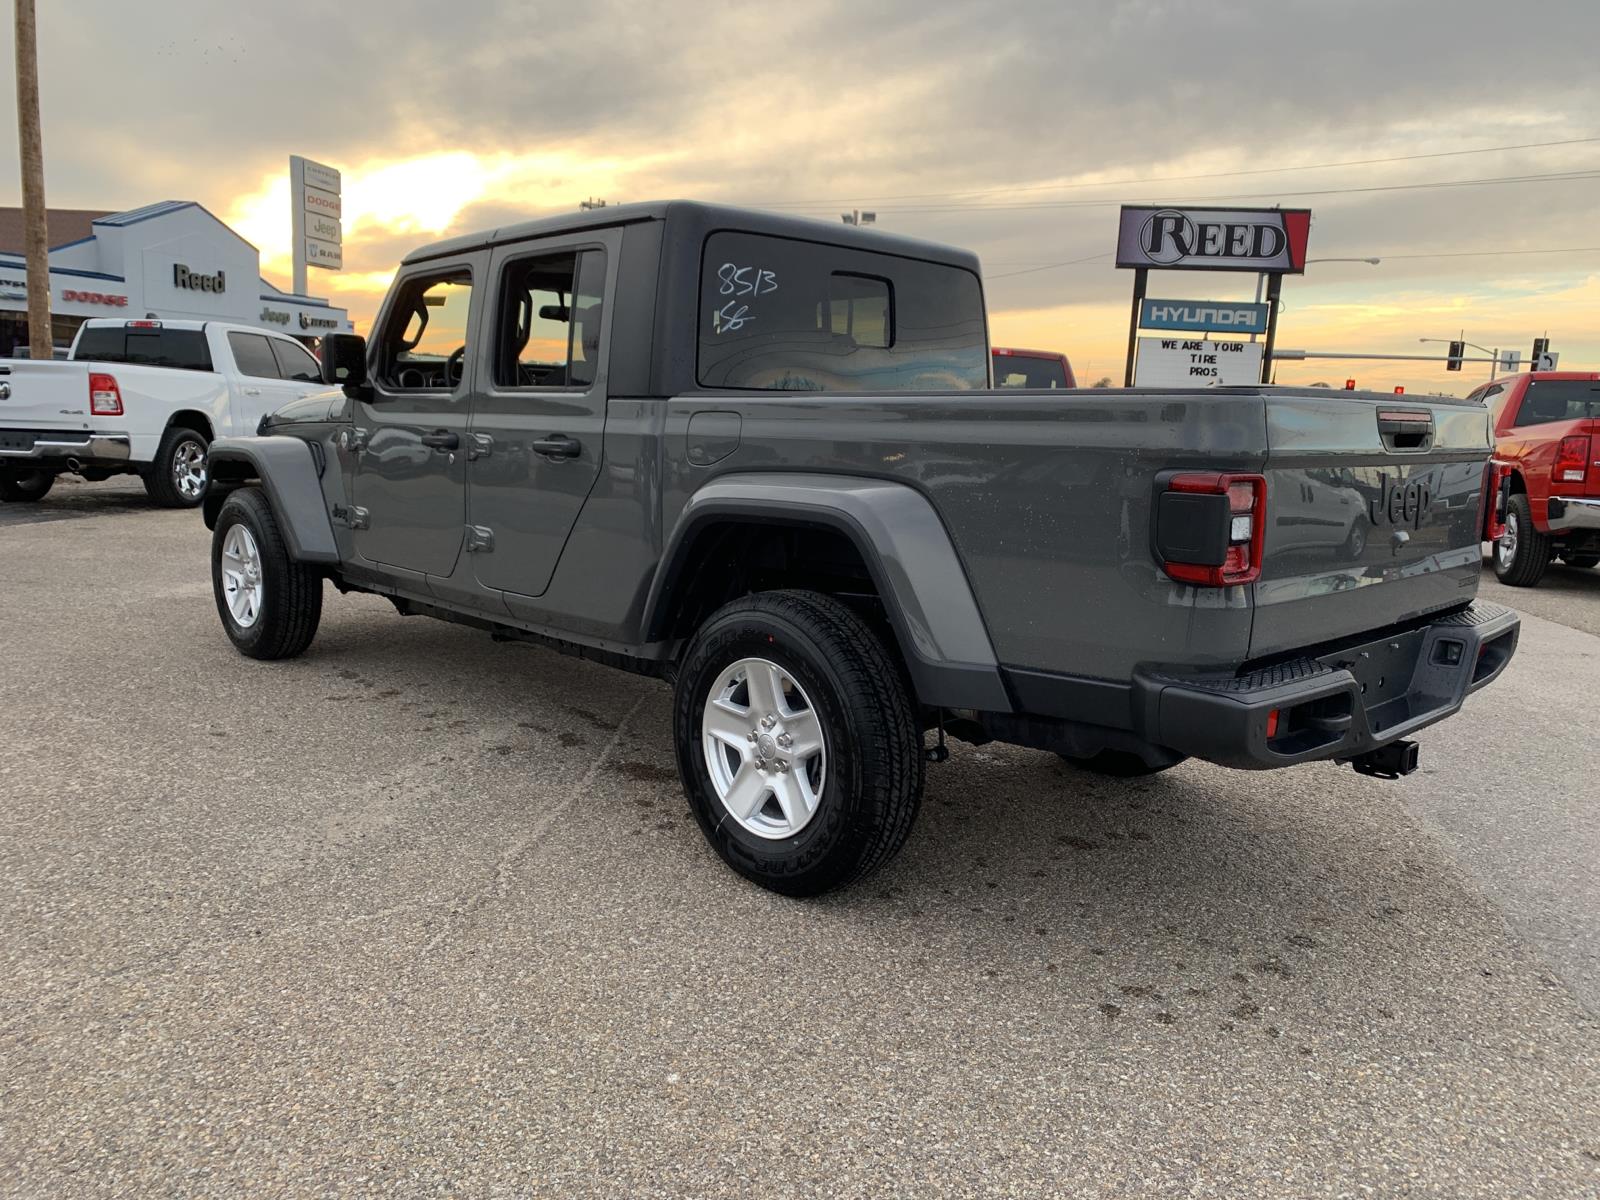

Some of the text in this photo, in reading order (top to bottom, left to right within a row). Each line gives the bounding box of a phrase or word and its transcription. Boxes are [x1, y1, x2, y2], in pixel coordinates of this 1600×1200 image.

[307, 195, 341, 210] DODGE
[314, 219, 337, 239] Jeep
[1147, 216, 1286, 258] REED
[320, 250, 341, 260] RAM
[173, 263, 226, 293] Reed
[718, 263, 778, 297] 8513
[62, 289, 129, 307] DODGE
[259, 307, 291, 326] Jeep
[1151, 306, 1257, 326] HYUNDAI
[1161, 340, 1244, 353] WE ARE YOUR
[1190, 353, 1217, 364] TIRE
[1189, 367, 1218, 377] PROS
[1369, 473, 1432, 530] Jeep
